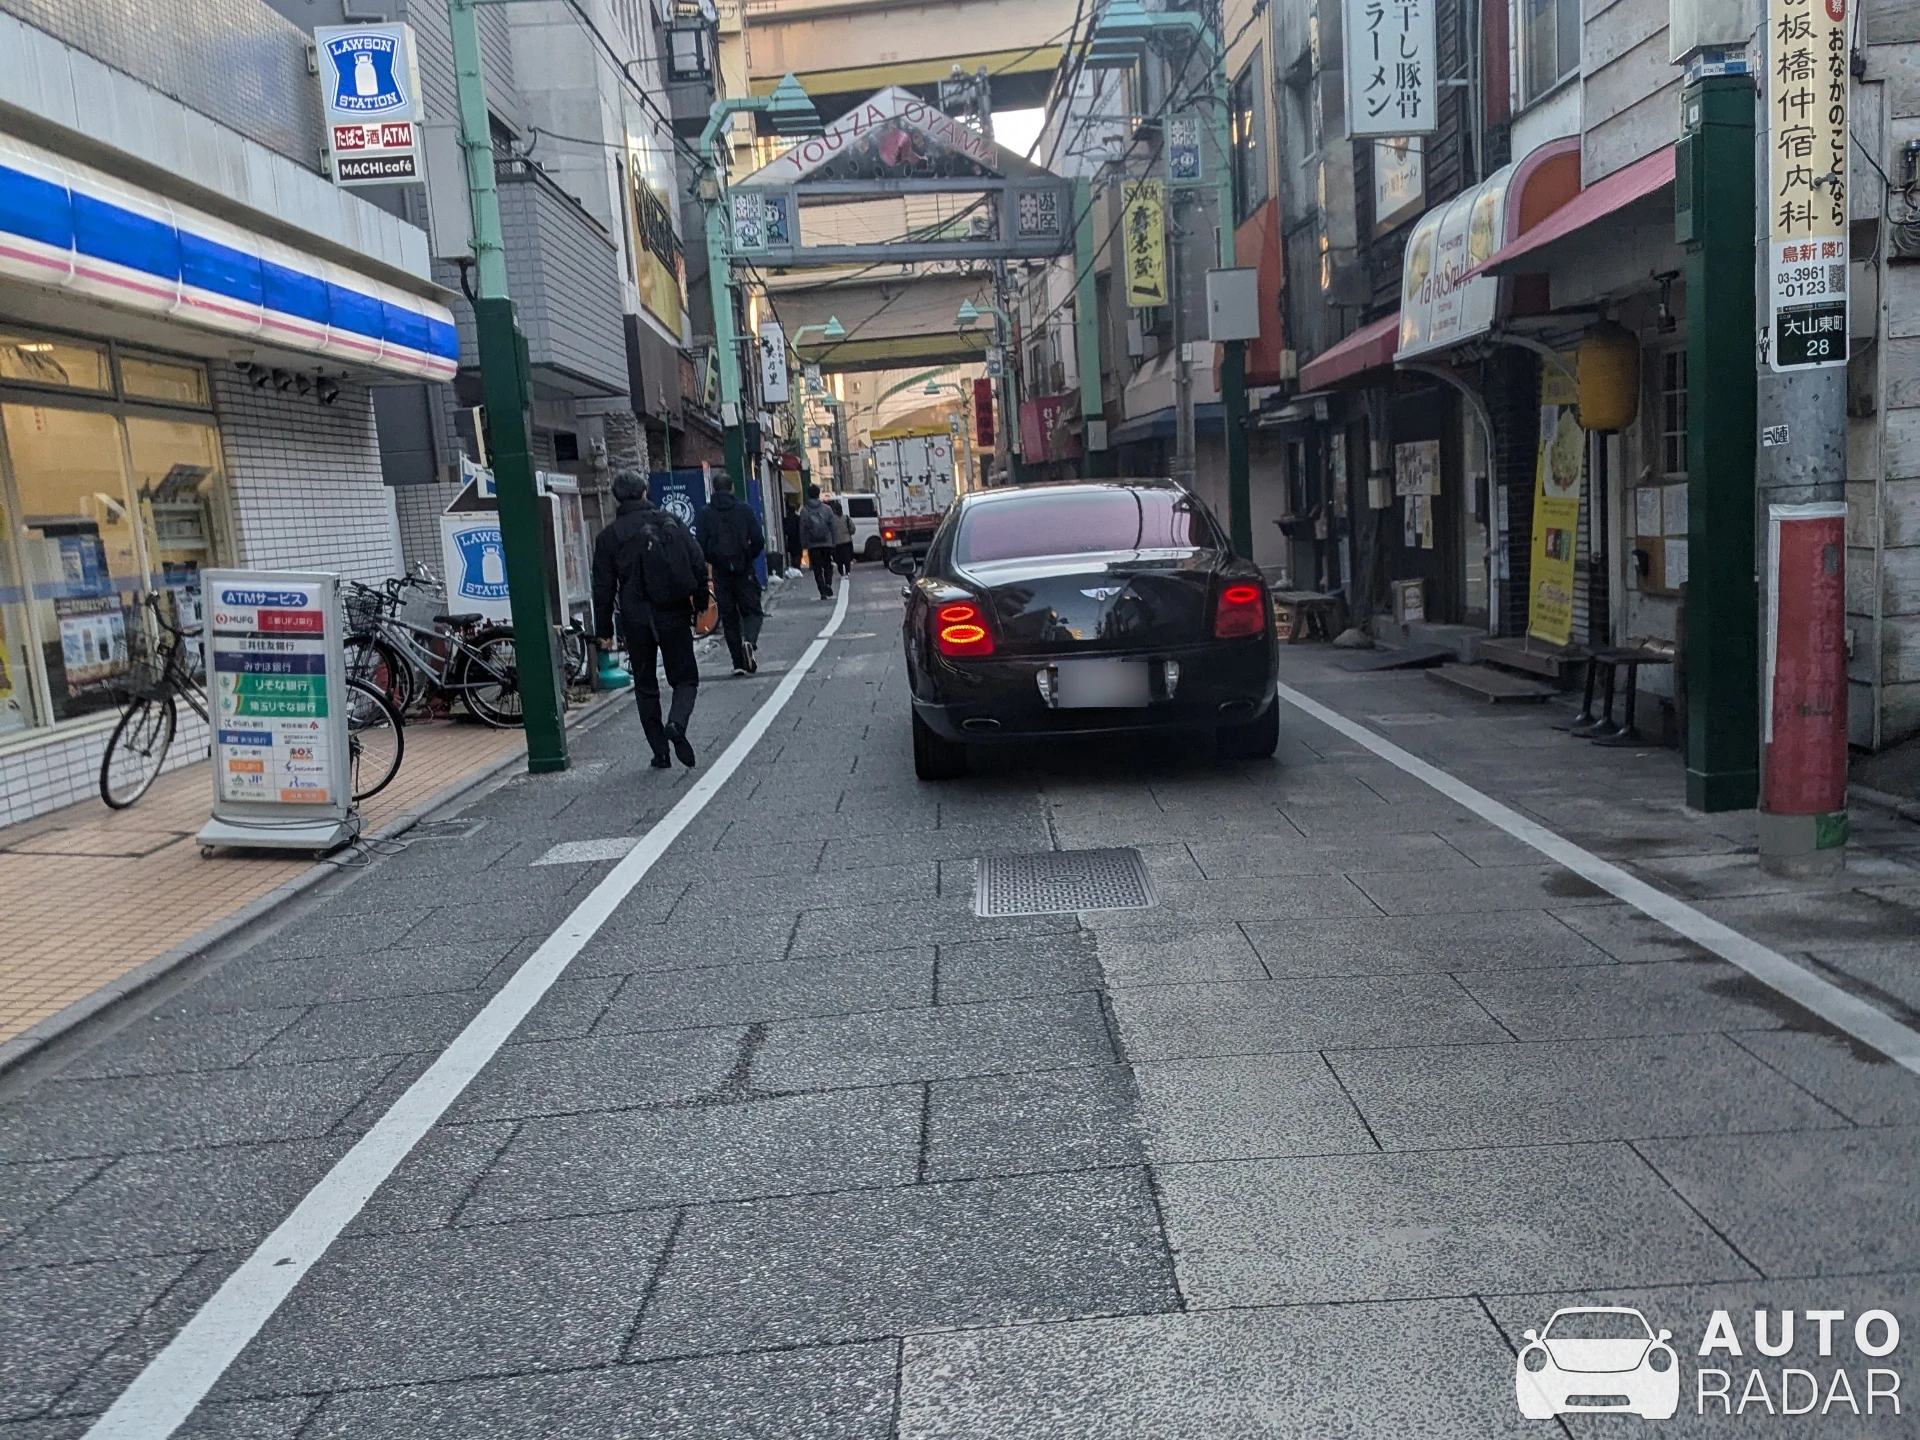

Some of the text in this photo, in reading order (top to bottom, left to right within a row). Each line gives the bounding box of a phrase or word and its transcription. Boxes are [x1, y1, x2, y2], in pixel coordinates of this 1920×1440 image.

[331, 38, 392, 56] LAWSON
[1392, 0, 1423, 119] 干し豚骨
[339, 92, 399, 110] STATION
[1776, 0, 1819, 234] 板橋仲宿内科
[904, 102, 999, 169] OYAMA
[1828, 27, 1845, 227] おなかのことなら
[336, 127, 411, 147] たばこ 酒 ATM
[341, 160, 412, 176] MACHI café
[1821, 241, 1844, 261] 隣り
[1777, 265, 1825, 285] 03-3961
[1778, 280, 1826, 298] -0123
[1784, 315, 1844, 337] 大山東町
[1806, 339, 1830, 357] 28
[881, 473, 950, 490] ヤマザキ
[459, 531, 503, 547] LAWS
[226, 591, 303, 605] ATMサービス
[465, 582, 510, 597] STATIO
[229, 616, 254, 624] MUFG
[239, 641, 295, 651] 三井住友銀行
[244, 661, 292, 673] みずほ銀行
[255, 680, 308, 692] りそな銀行
[250, 702, 316, 713] 埼玉りそな銀行
